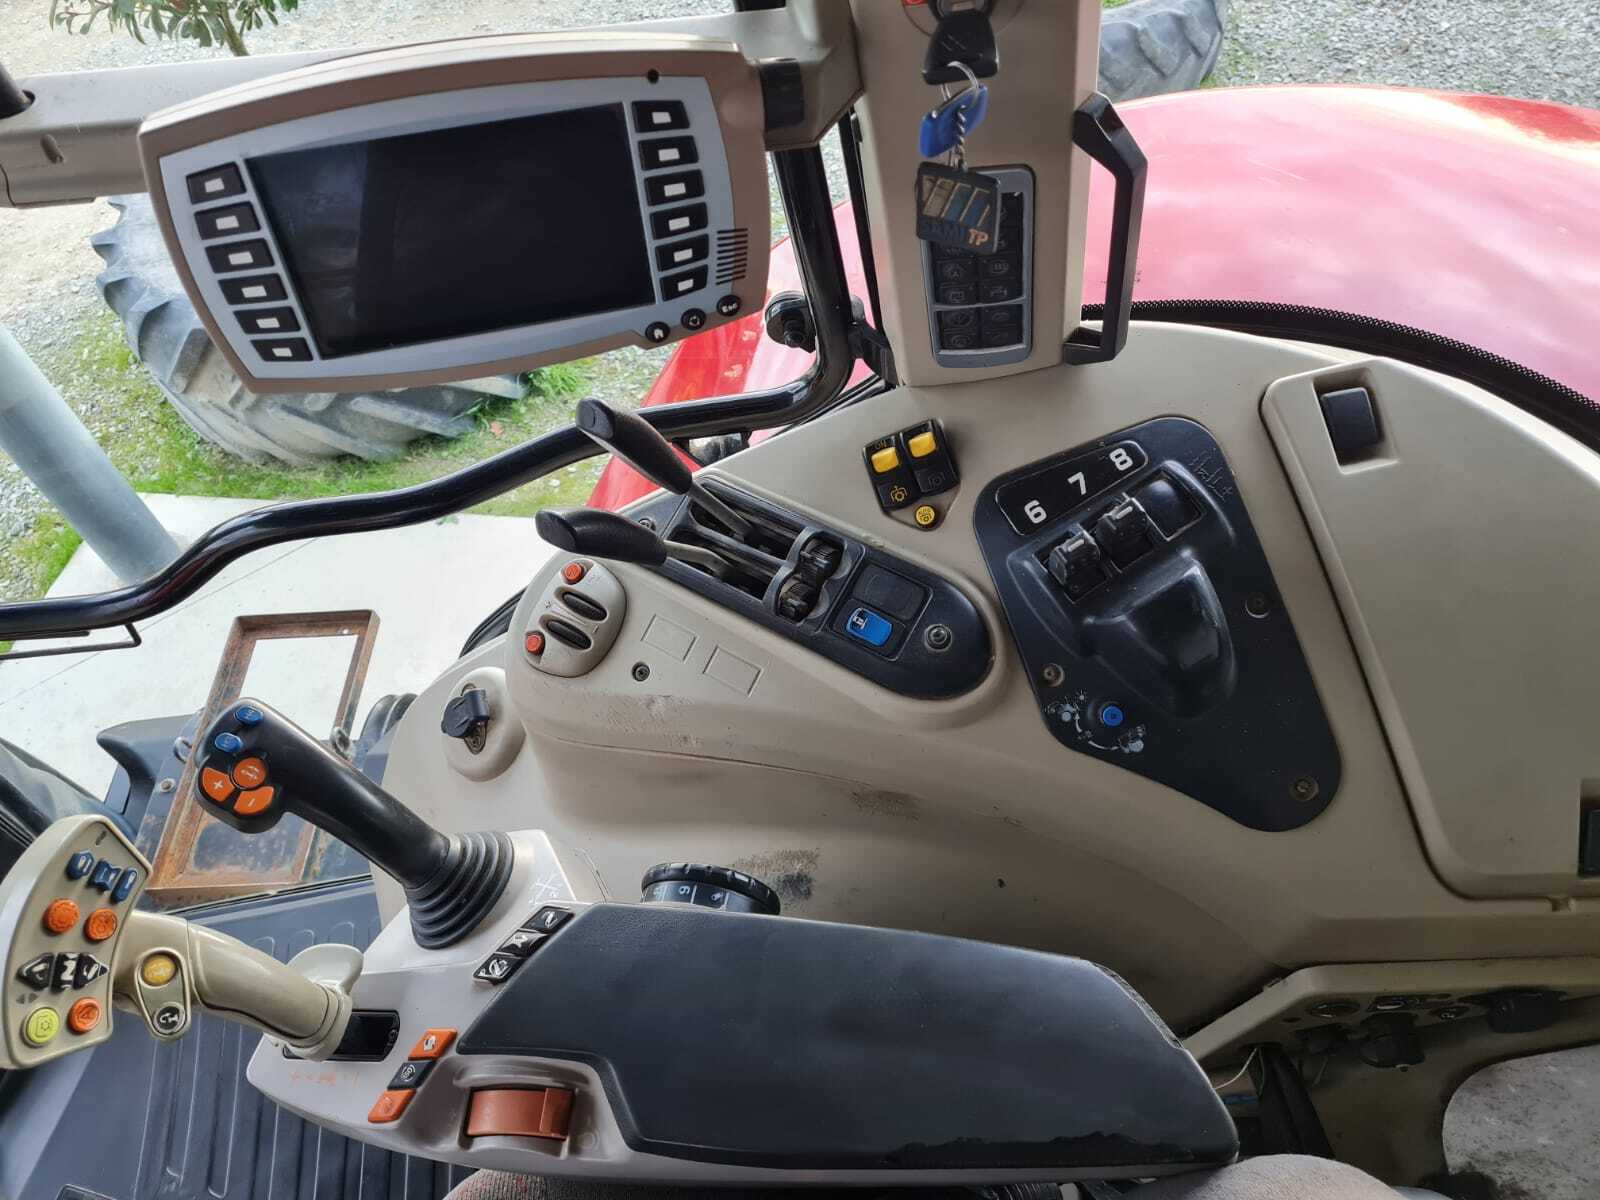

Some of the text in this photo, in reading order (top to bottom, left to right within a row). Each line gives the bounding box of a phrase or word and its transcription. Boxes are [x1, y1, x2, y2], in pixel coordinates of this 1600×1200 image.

[969, 228, 989, 246] TP
[721, 302, 738, 313] Esc
[1024, 448, 1133, 524] 6 7 8
